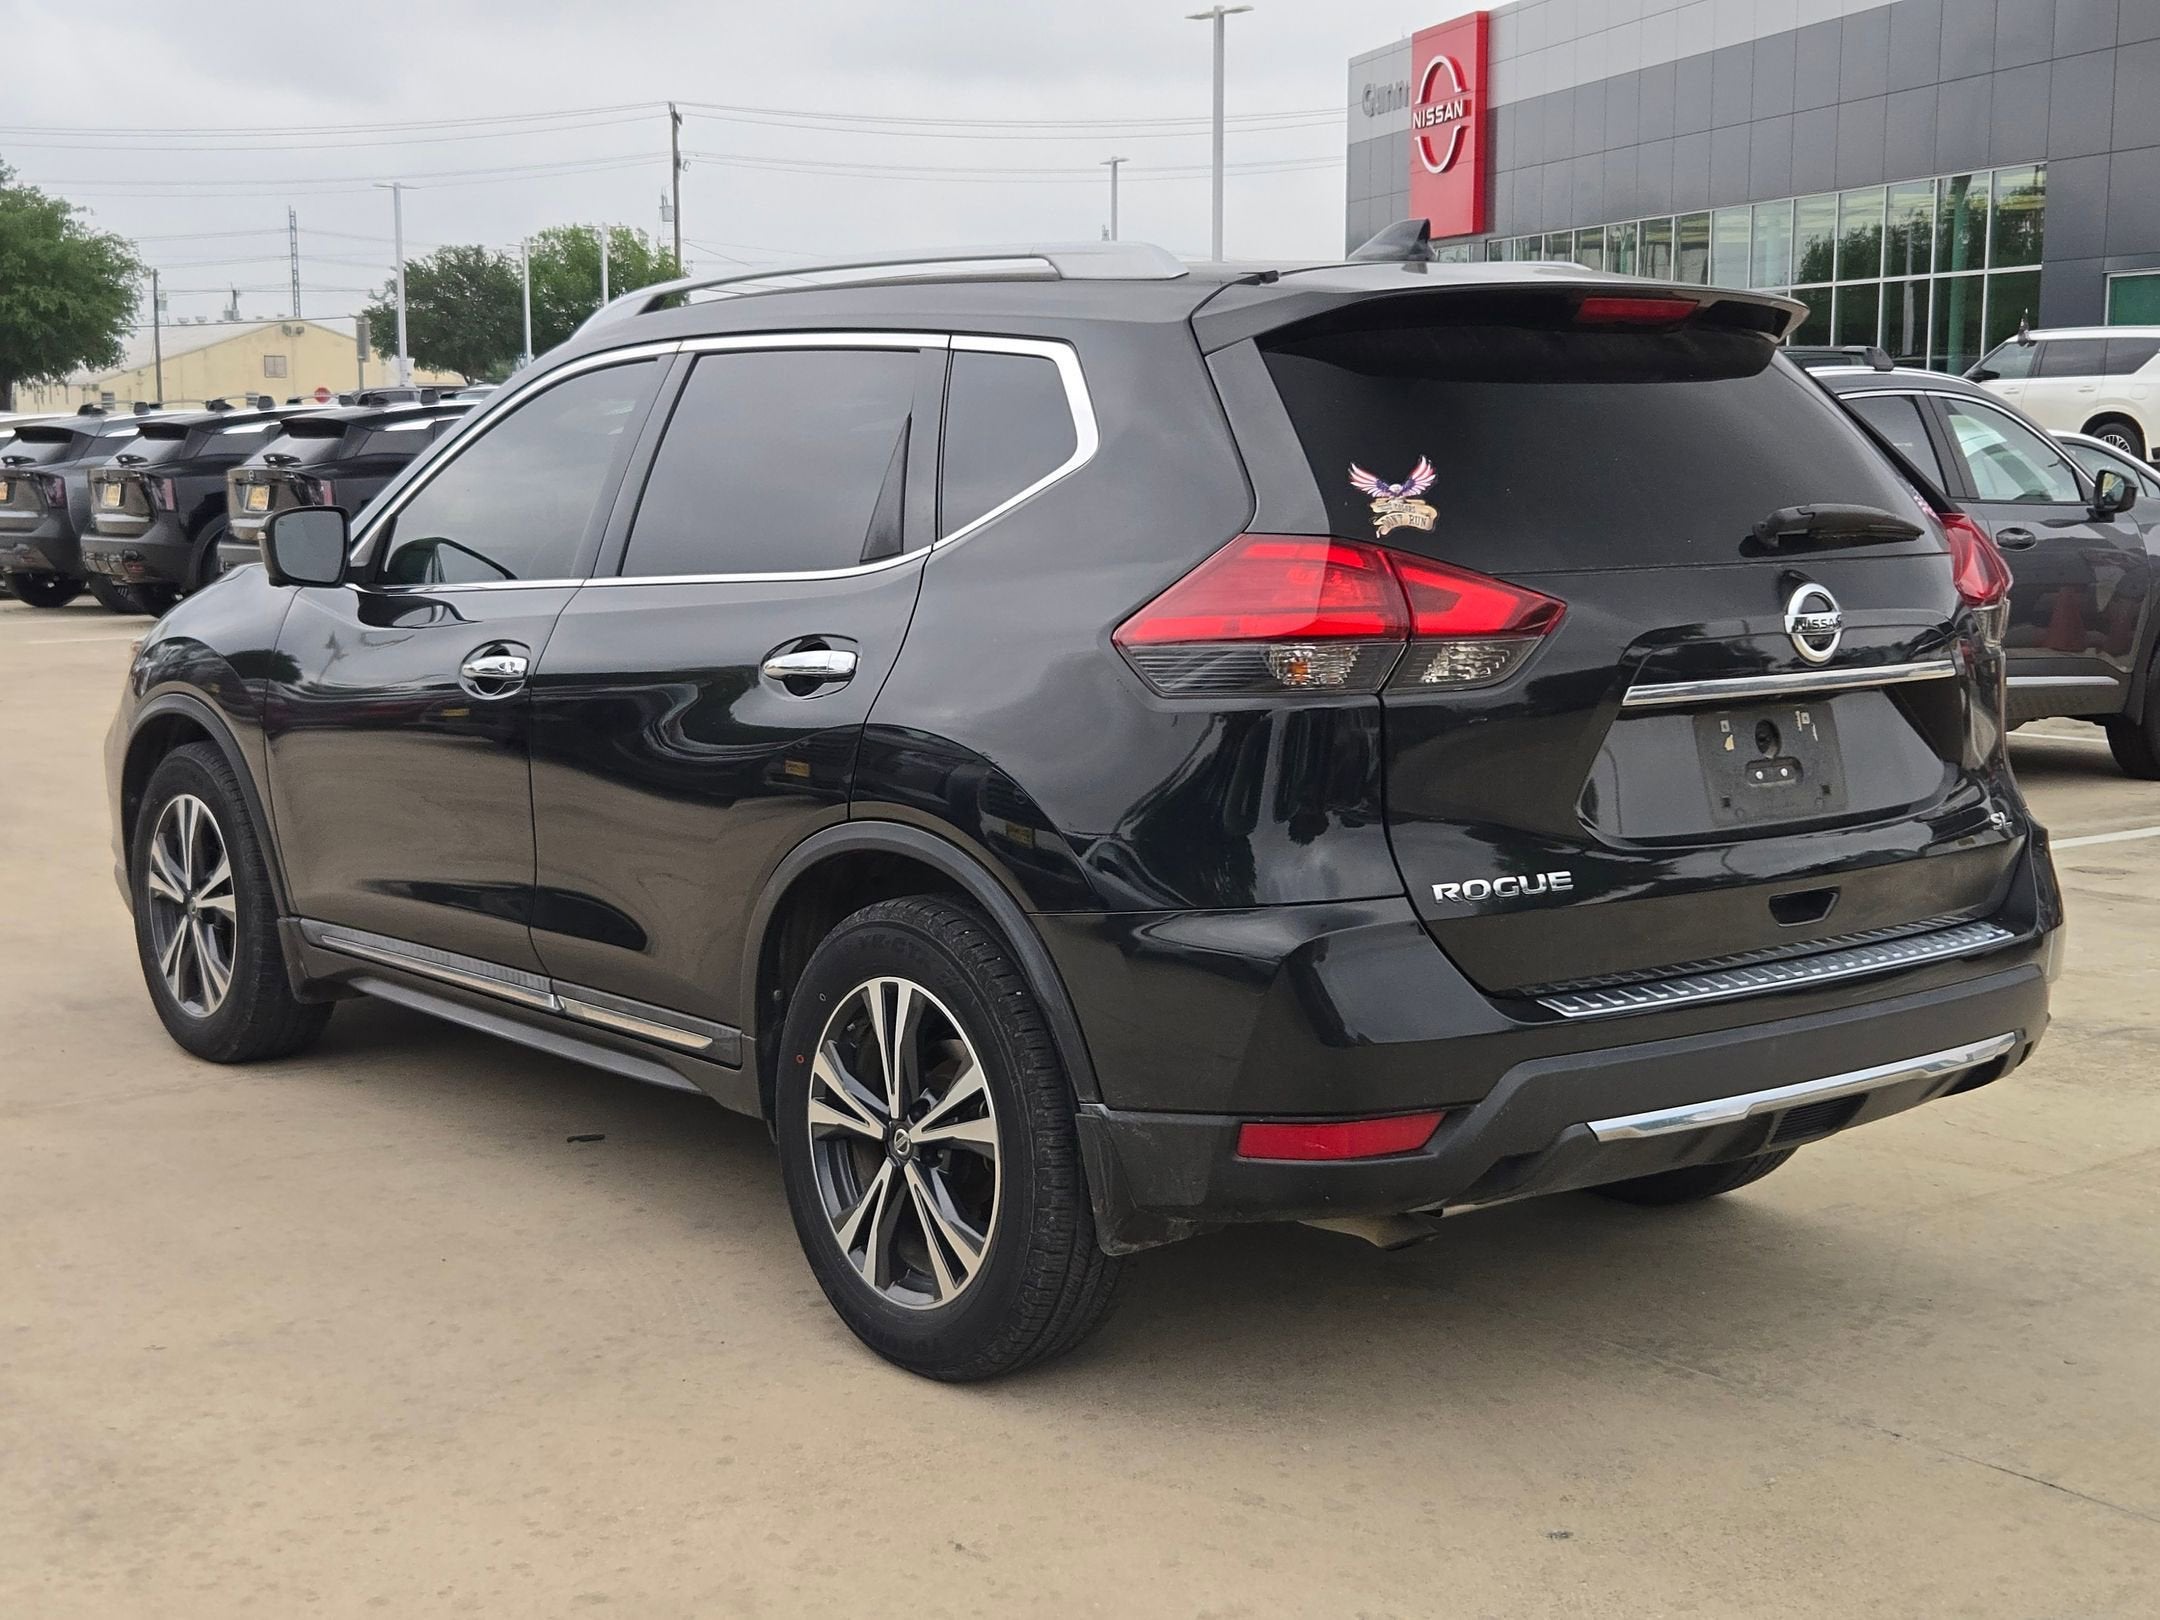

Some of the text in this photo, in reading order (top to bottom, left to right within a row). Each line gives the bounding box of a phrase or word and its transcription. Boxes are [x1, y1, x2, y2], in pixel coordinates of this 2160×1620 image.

[1412, 98, 1463, 129] NISSAN
[1408, 514, 1427, 528] RUN
[1794, 614, 1841, 632] NISSAN
[1431, 870, 1574, 903] ROGUE
